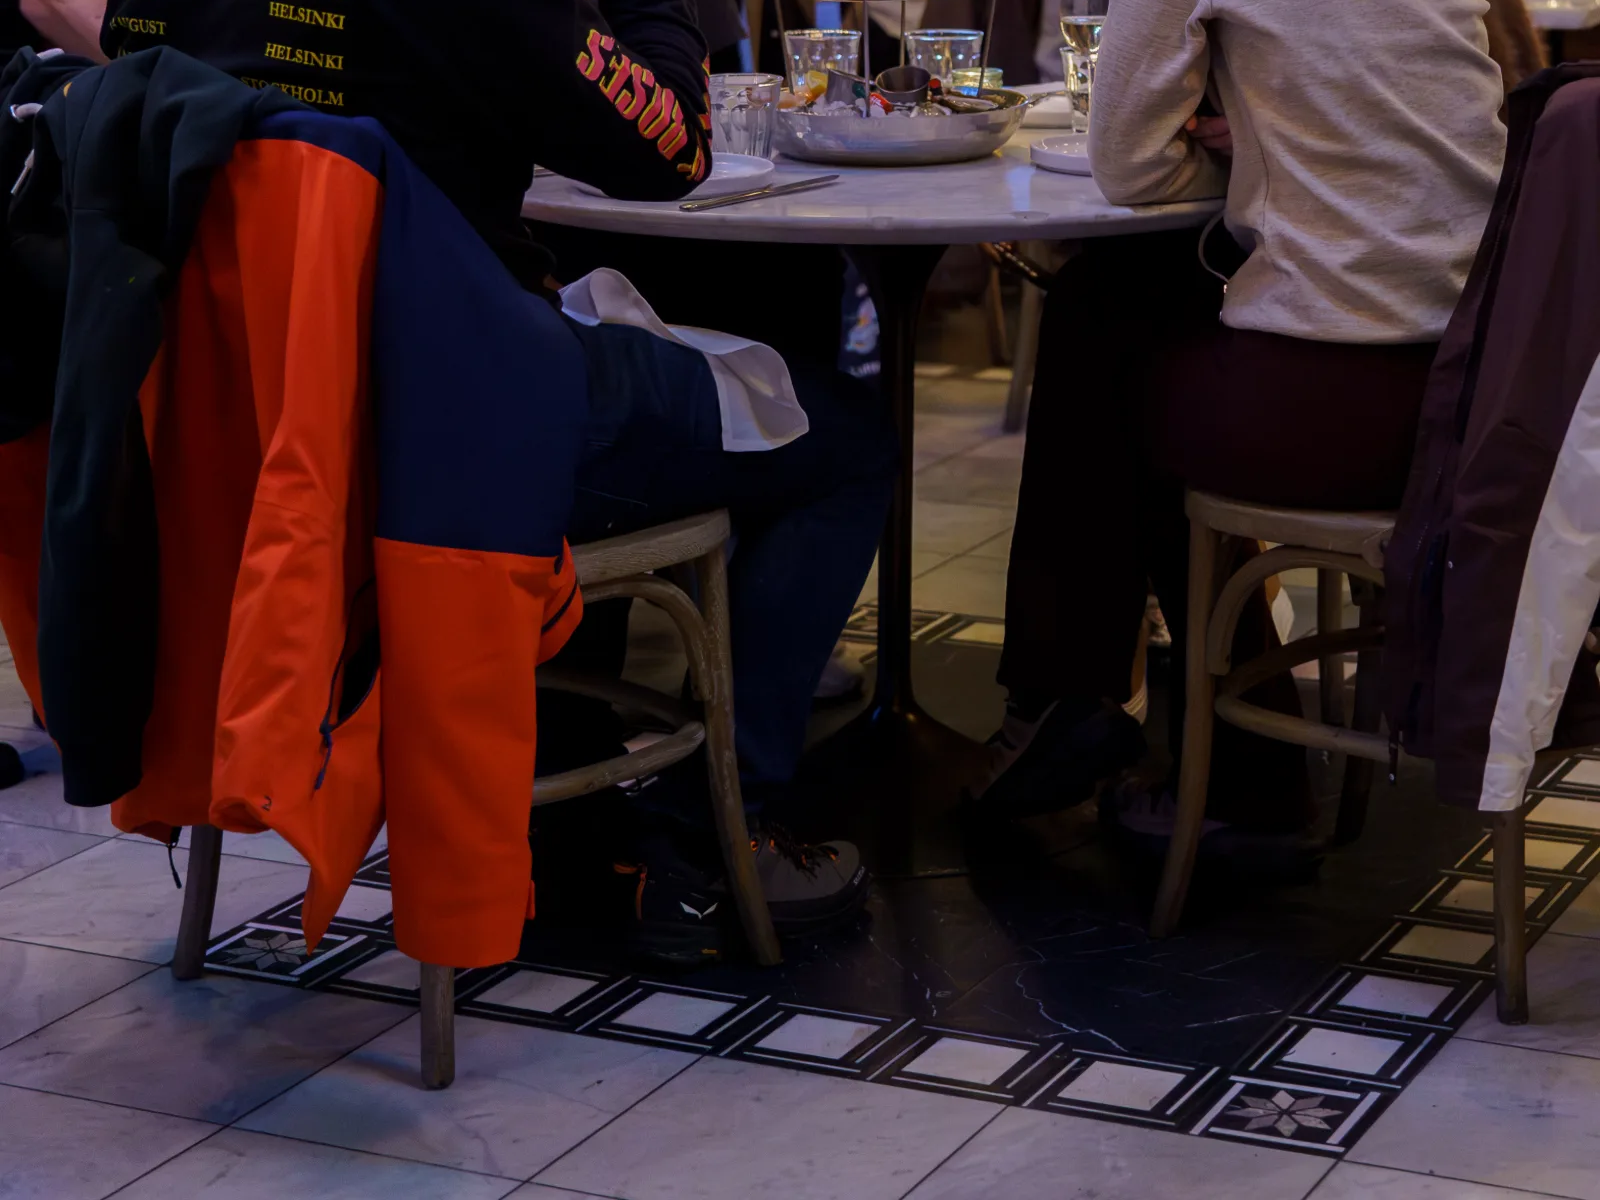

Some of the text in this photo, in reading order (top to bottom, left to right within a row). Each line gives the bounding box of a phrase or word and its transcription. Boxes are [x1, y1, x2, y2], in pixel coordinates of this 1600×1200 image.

[269, 1, 345, 30] HELSINKI
[264, 42, 344, 70] HELSINKI
[576, 28, 688, 161] ROSES
